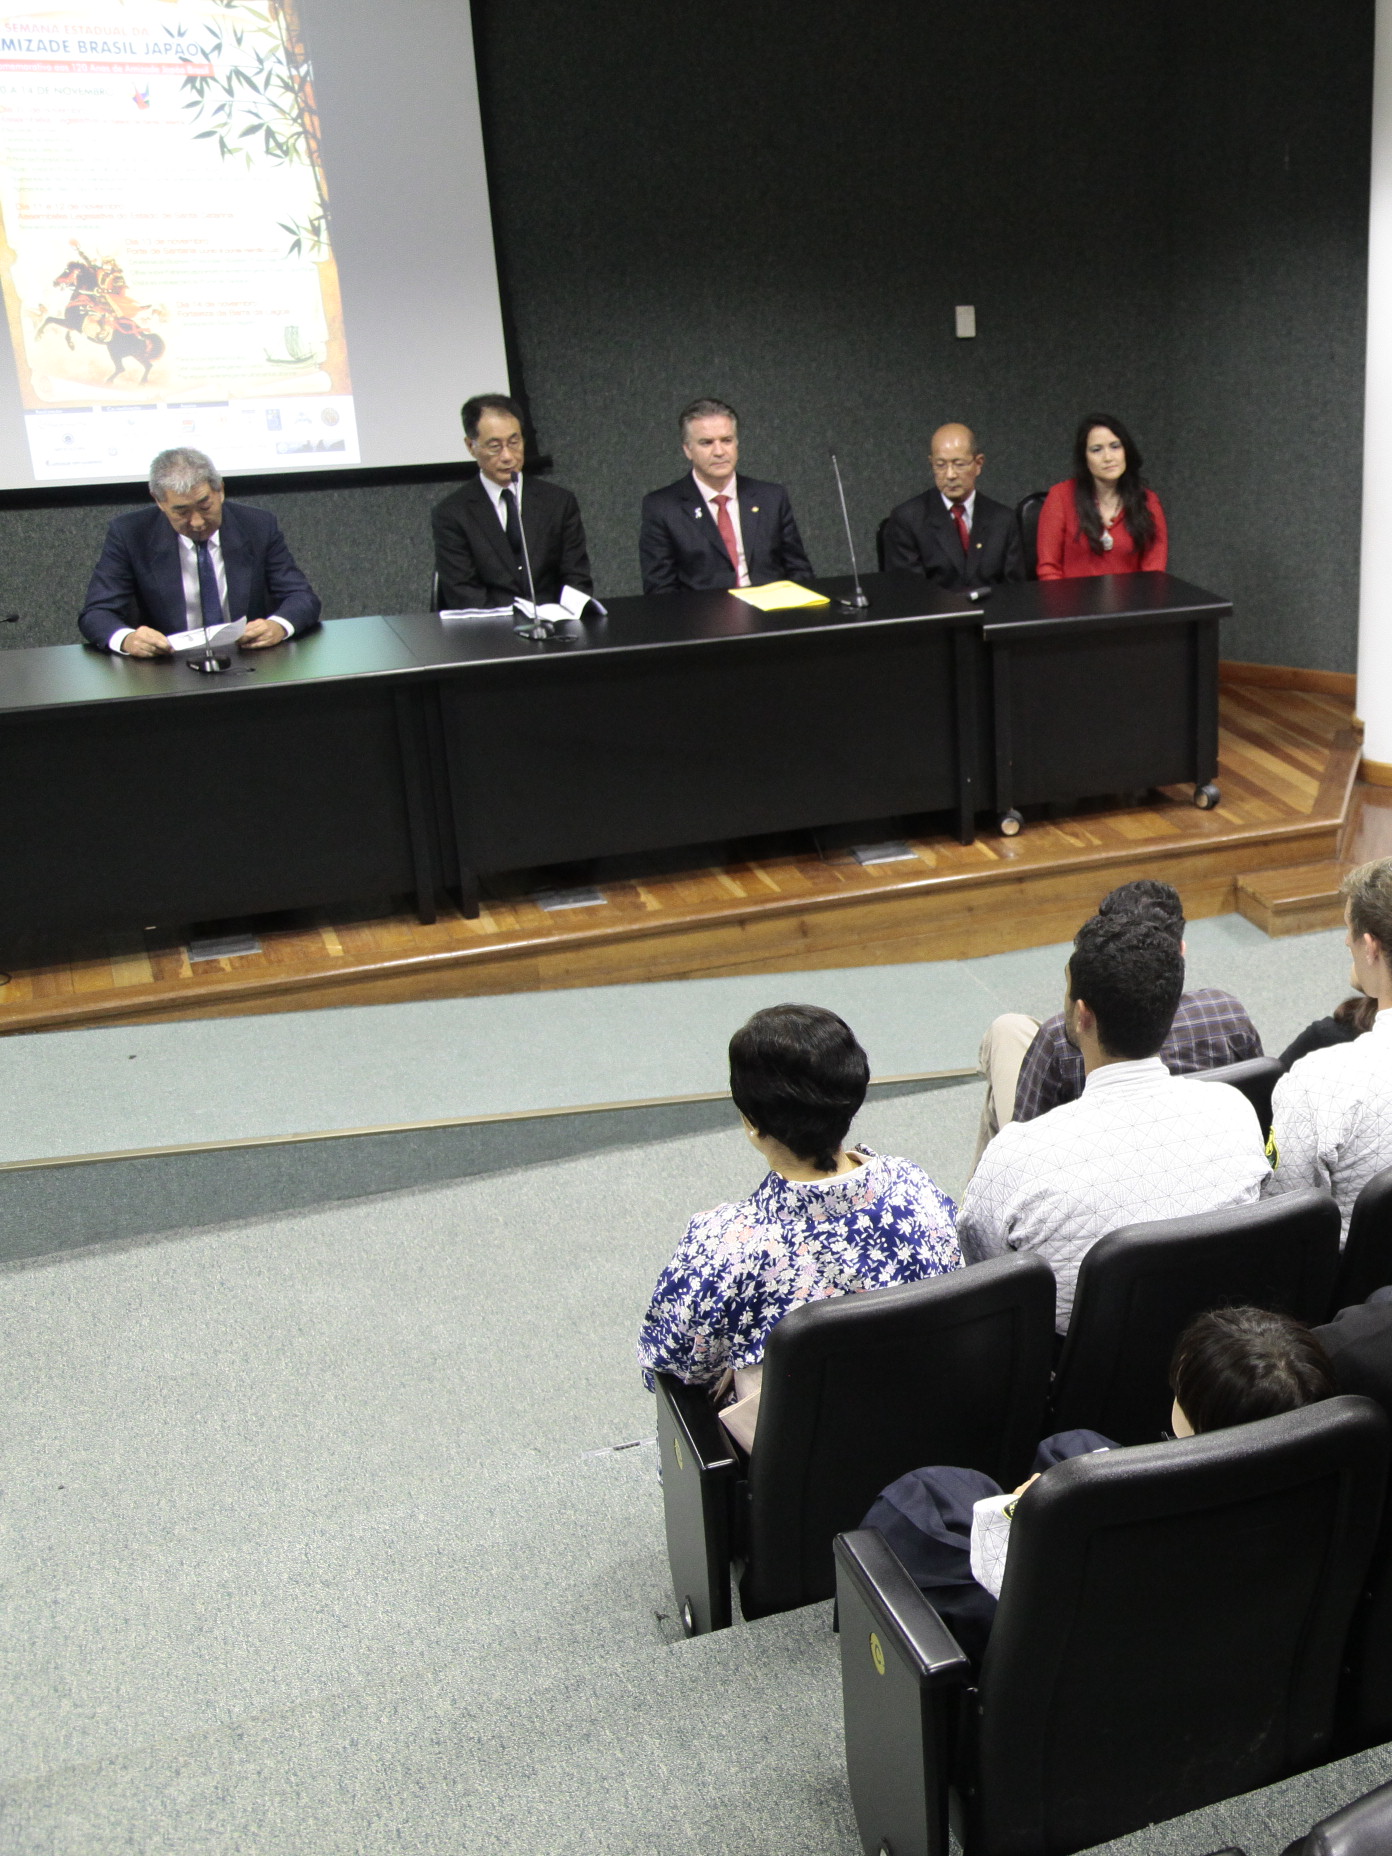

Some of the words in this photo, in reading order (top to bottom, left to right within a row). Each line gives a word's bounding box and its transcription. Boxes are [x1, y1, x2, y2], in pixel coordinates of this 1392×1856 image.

[4, 23, 60, 33] SEMANA
[64, 25, 127, 36] ESTADUAL
[132, 27, 150, 36] DA
[0, 38, 71, 53] MIZADE
[77, 40, 137, 55] BRASIL
